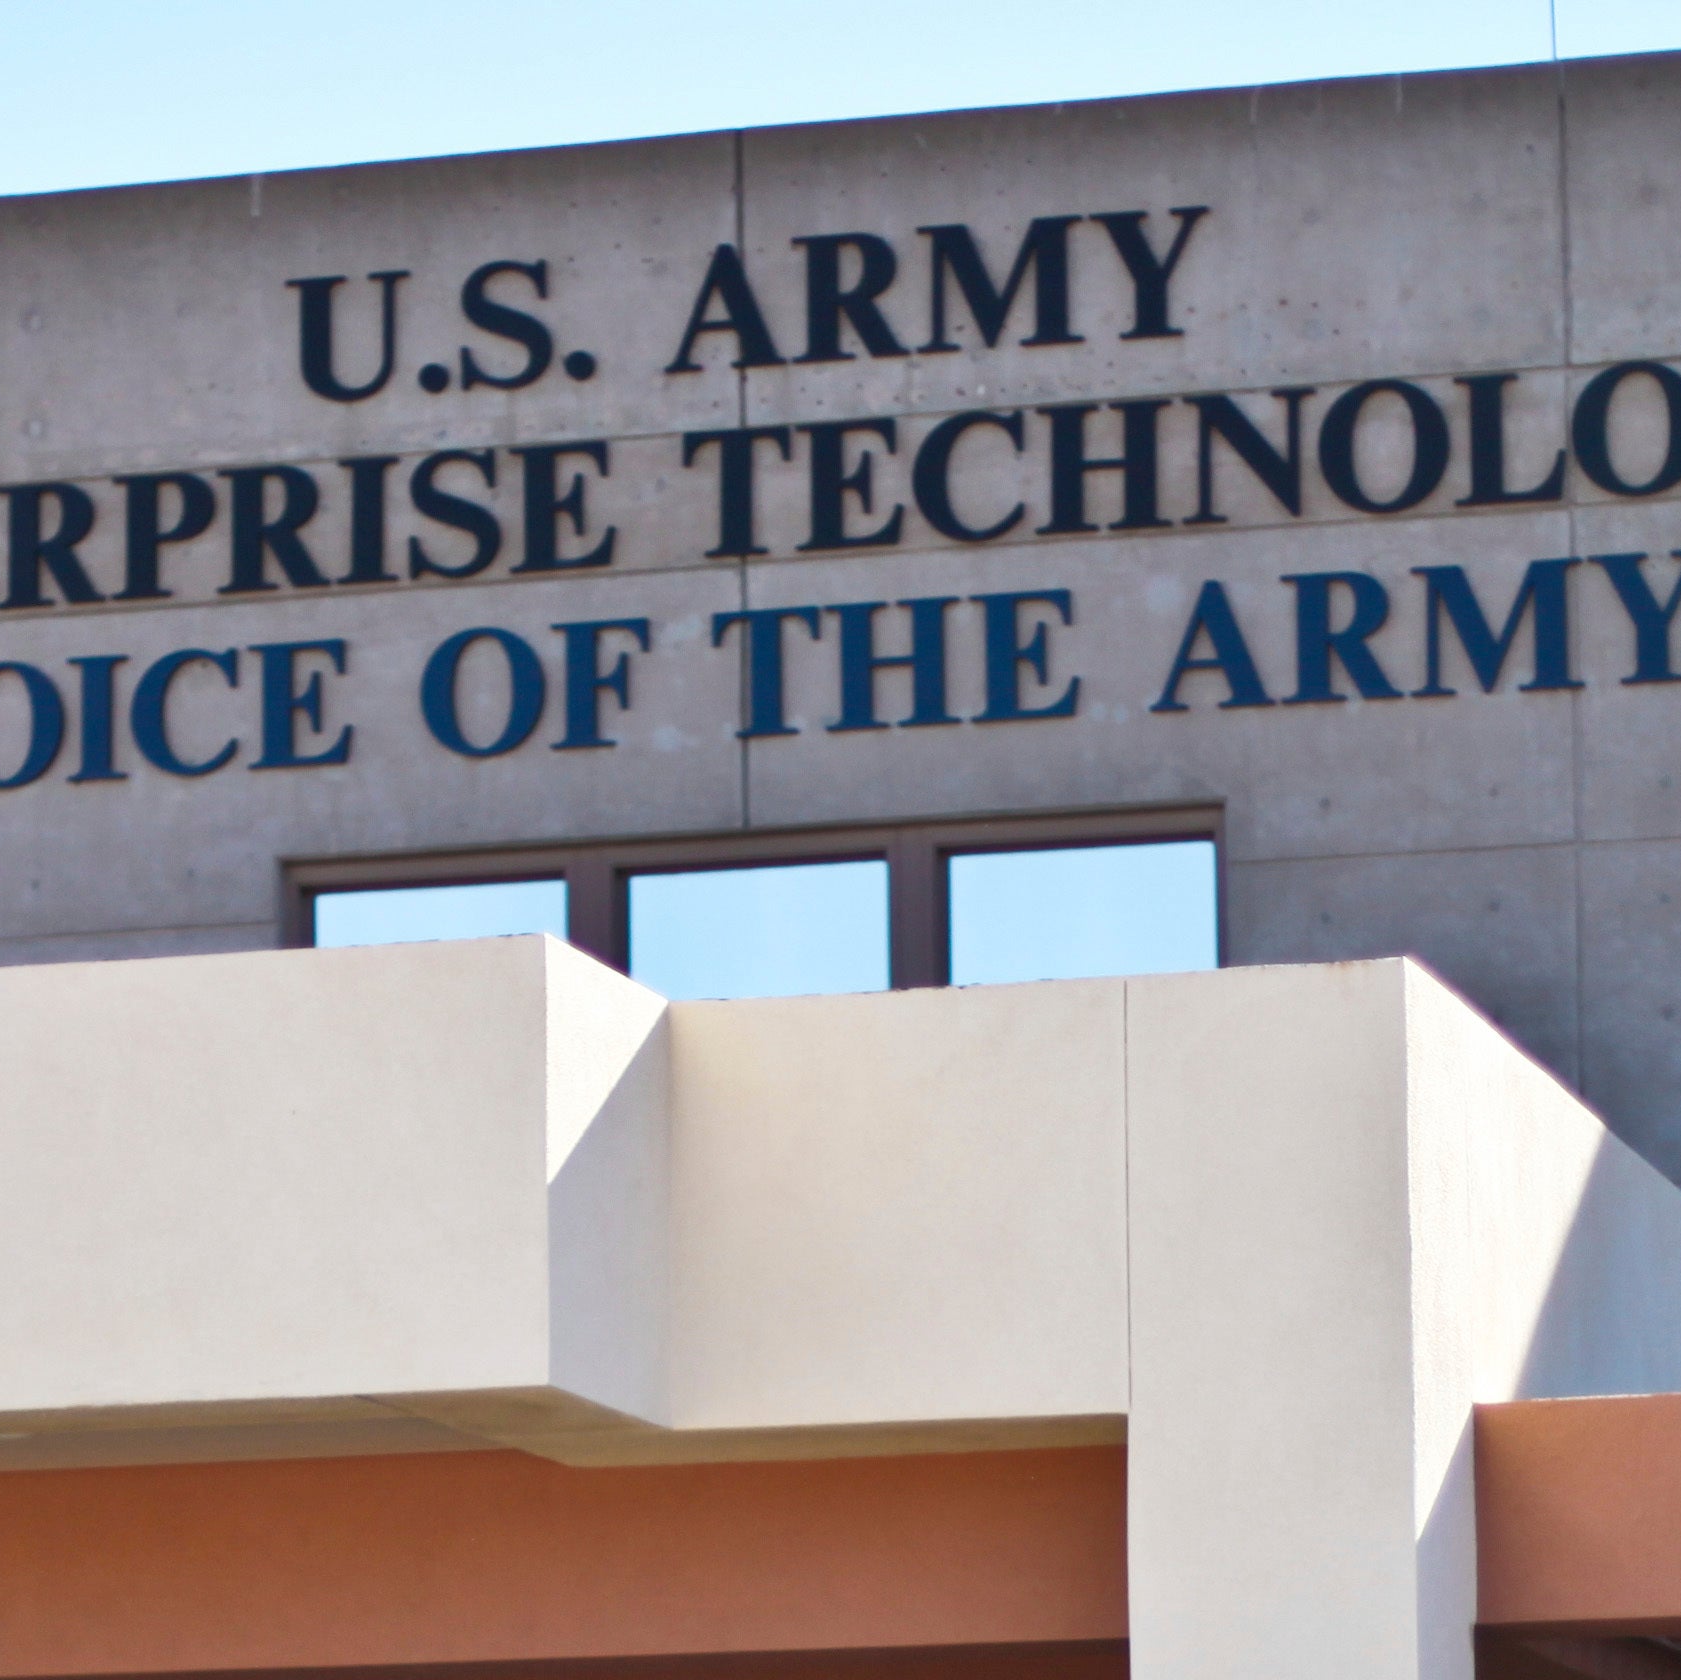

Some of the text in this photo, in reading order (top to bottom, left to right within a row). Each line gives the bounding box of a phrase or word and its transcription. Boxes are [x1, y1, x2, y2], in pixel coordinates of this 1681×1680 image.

[288, 205, 1208, 402] U.S. ARMY
[420, 617, 651, 758] OF
[711, 588, 1080, 741] THE
